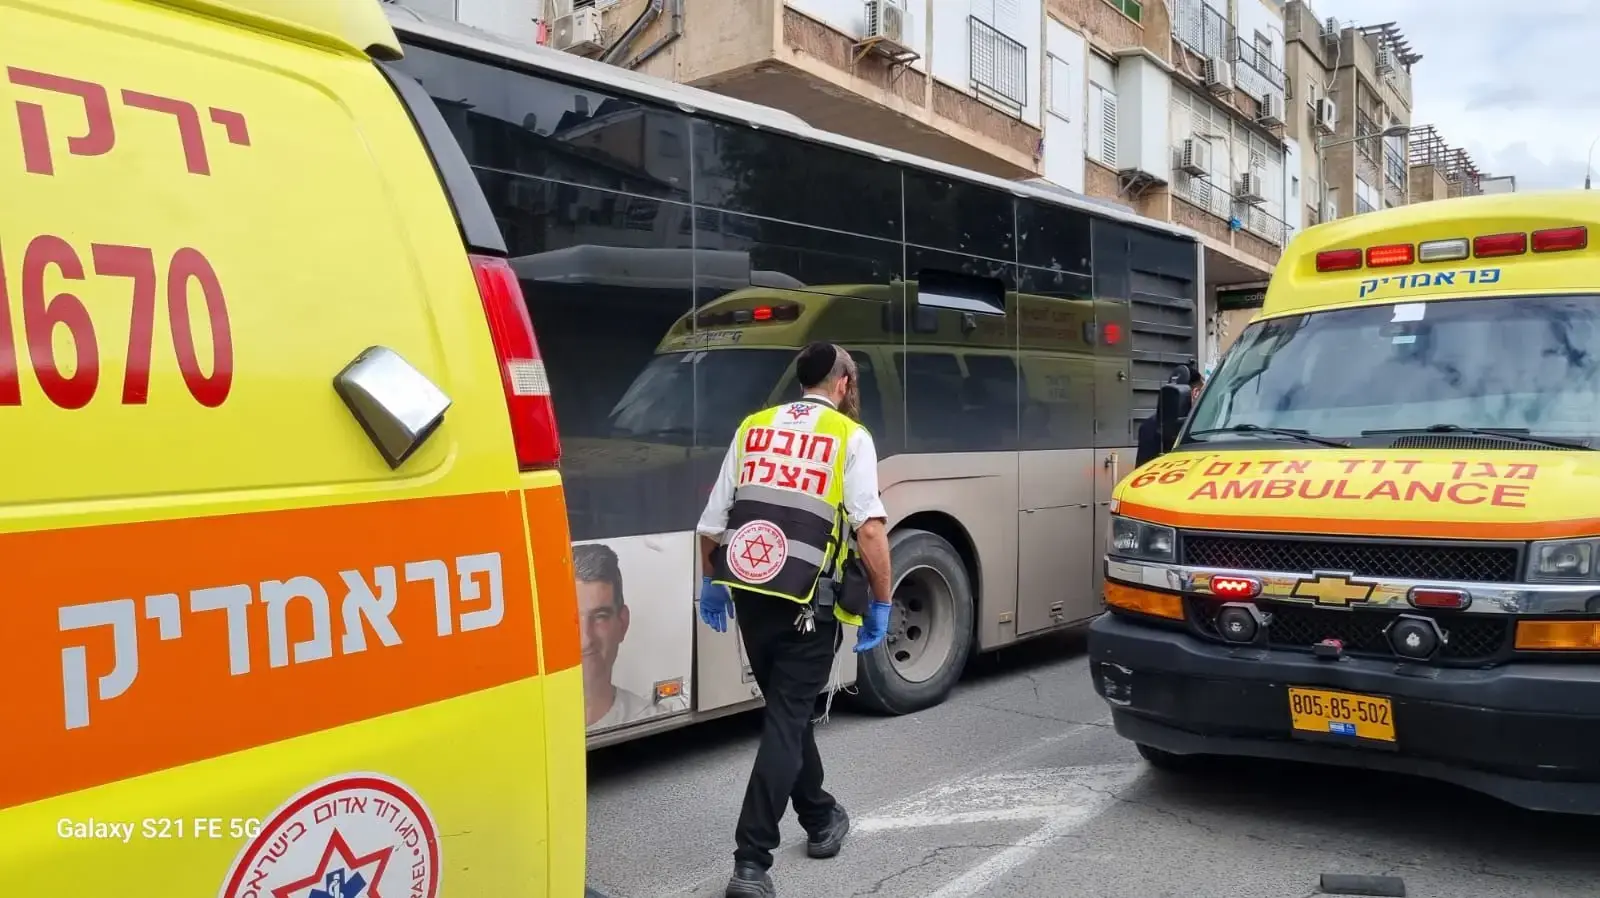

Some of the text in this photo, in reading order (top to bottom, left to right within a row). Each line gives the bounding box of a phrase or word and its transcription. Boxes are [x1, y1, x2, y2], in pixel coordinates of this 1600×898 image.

[1359, 268, 1501, 298] פראמדיק
[744, 428, 834, 463] חובש
[740, 457, 828, 495] הצלה
[1130, 468, 1189, 489] 66
[1203, 459, 1538, 480] מגן דוד אדום
[1188, 478, 1530, 509] AMBULANCE
[58, 551, 505, 730] פראמדיק
[1293, 694, 1390, 726] 805-85-502
[313, 796, 368, 825] אדום
[373, 798, 401, 824] דוד
[394, 816, 419, 848] מגן
